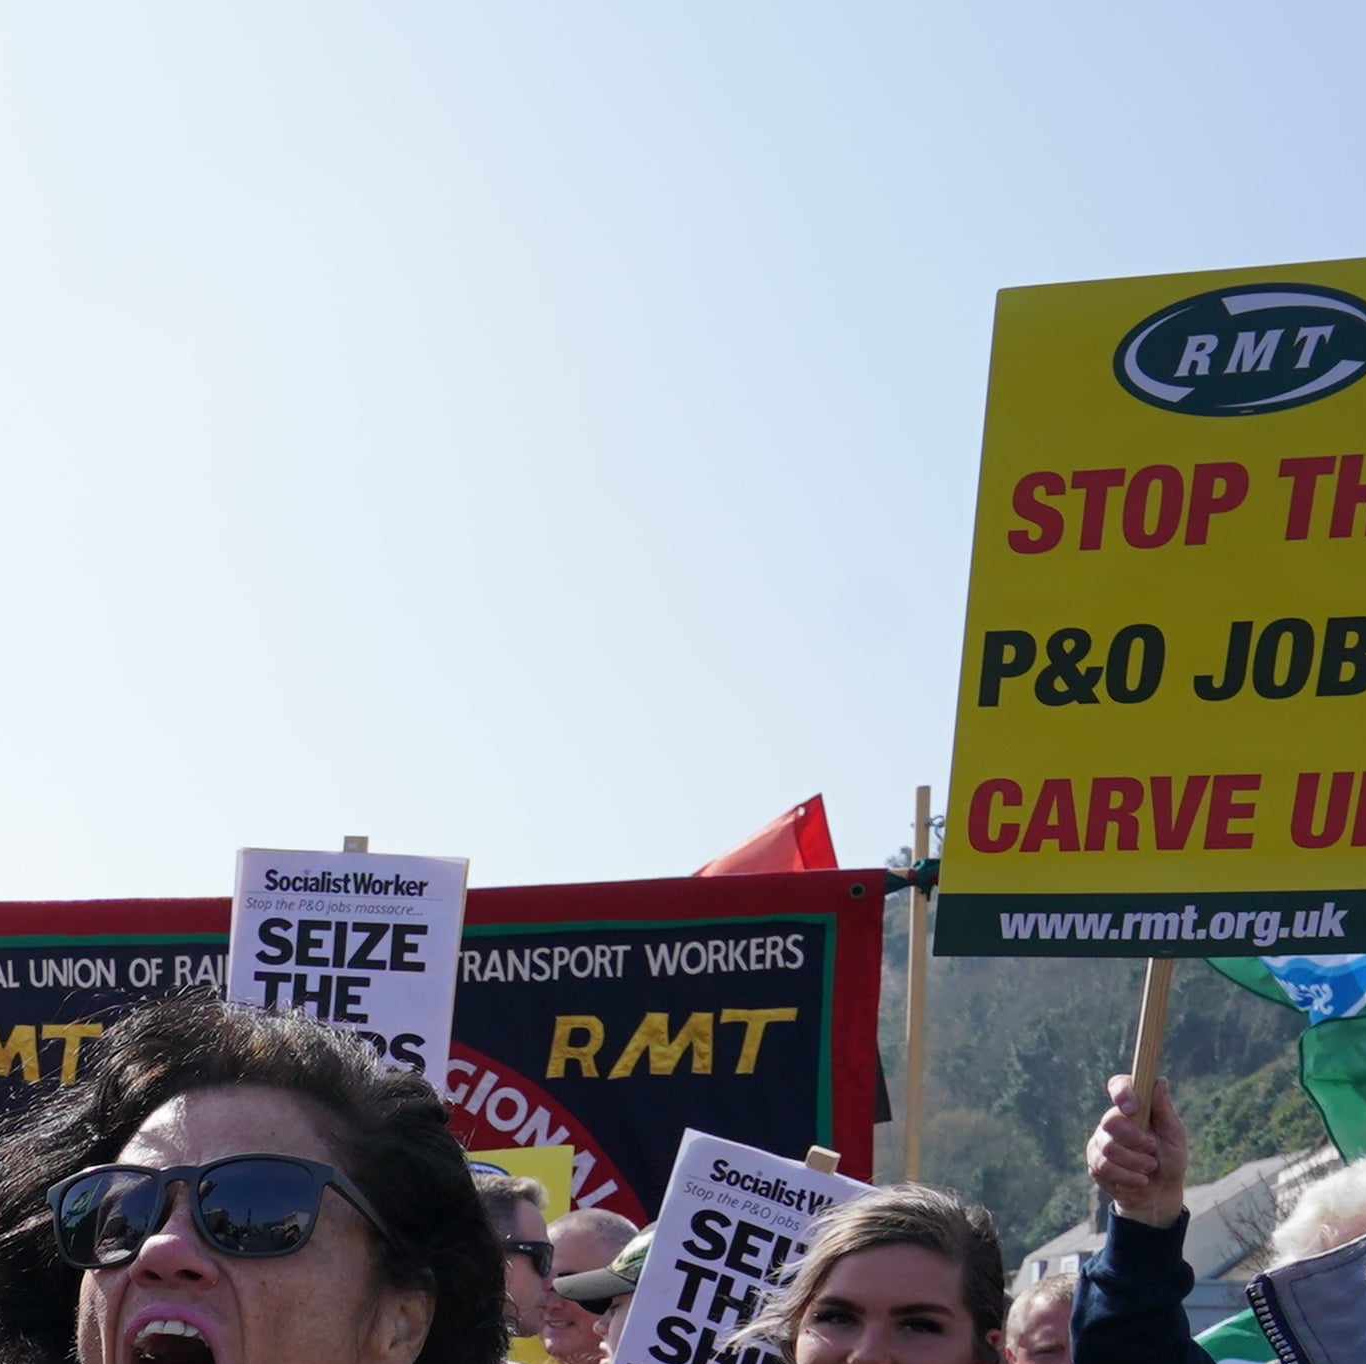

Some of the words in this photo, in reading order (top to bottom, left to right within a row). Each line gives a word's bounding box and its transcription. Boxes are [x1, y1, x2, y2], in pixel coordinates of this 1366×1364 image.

[1173, 324, 1336, 378] RMT
[1007, 462, 1250, 555] STOP
[977, 623, 1166, 708] P&O
[967, 773, 1262, 854] CARVE
[246, 897, 272, 912] Stop
[275, 898, 295, 912] the
[298, 899, 325, 912] P&O
[326, 900, 352, 916] jobs
[1000, 902, 1348, 947] www.rmt.org.uk
[29, 957, 116, 988] UNION
[128, 956, 163, 987] OF
[174, 953, 230, 986] RAI
[457, 943, 632, 983] RANSPORT
[644, 934, 805, 977] WORKERS
[255, 918, 429, 972] SEIZE
[254, 971, 371, 1024] THE
[546, 1007, 798, 1080] RMT
[444, 1058, 619, 1210] GIONAL
[684, 1181, 715, 1200] Stop
[717, 1192, 740, 1209] the
[740, 1199, 772, 1220] P&O
[769, 1212, 802, 1232] jobs
[674, 1258, 765, 1328] TH
